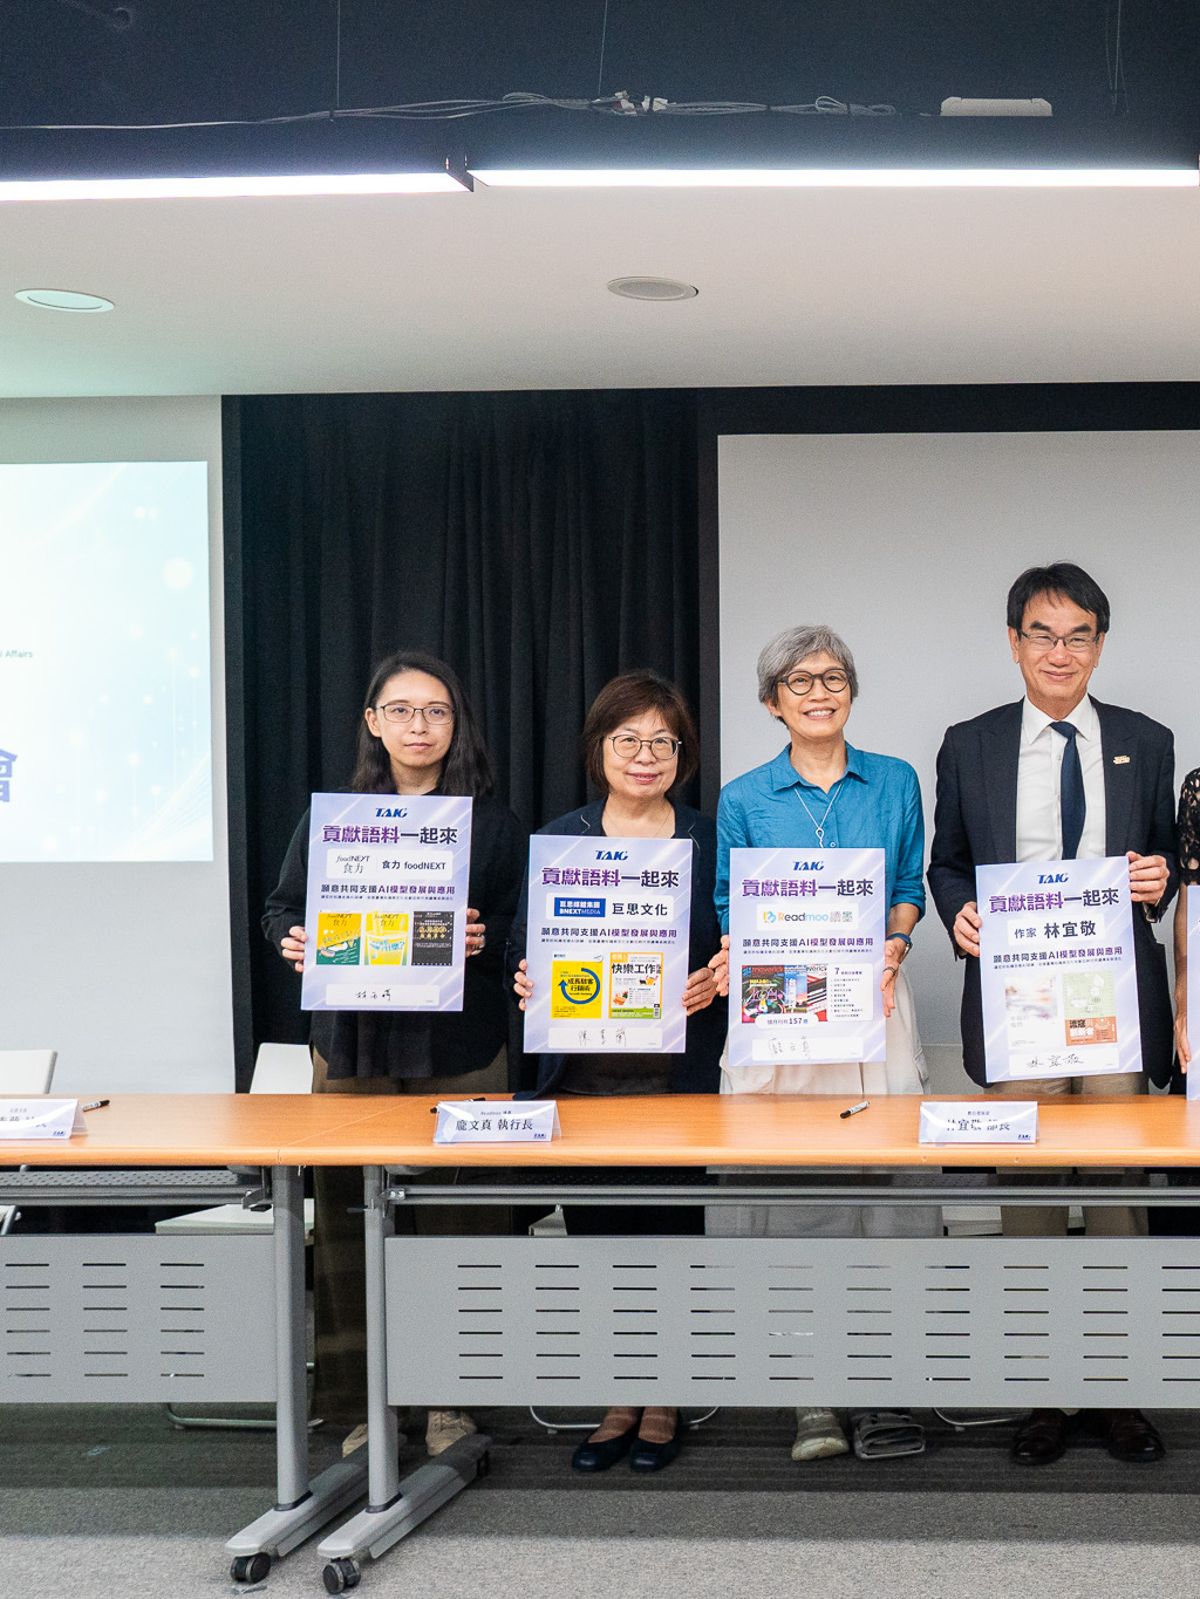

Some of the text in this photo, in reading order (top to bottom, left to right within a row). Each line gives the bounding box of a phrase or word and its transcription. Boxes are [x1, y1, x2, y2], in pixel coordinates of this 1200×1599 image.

[322, 826, 457, 844] 貢獻語料一起來
[382, 861, 446, 870] 食力 foodNEXT
[542, 868, 679, 888] 貢獻語料一起來
[321, 885, 455, 894] 願意共同支援AI模型發展與應用
[742, 879, 873, 897] 貢獻語料一起來
[989, 888, 1119, 913] 貢獻語料一起來
[612, 903, 668, 916] 巨思文化
[541, 928, 677, 938] 願意共同支援AI模型發展與應用
[1014, 920, 1096, 939] 作家 林宜敬
[743, 938, 873, 947] 願意共同支援AI模型發展與應用
[993, 946, 1123, 963] 願意共同支援AI模型發展與應用
[498, 1119, 533, 1130] 執行長
